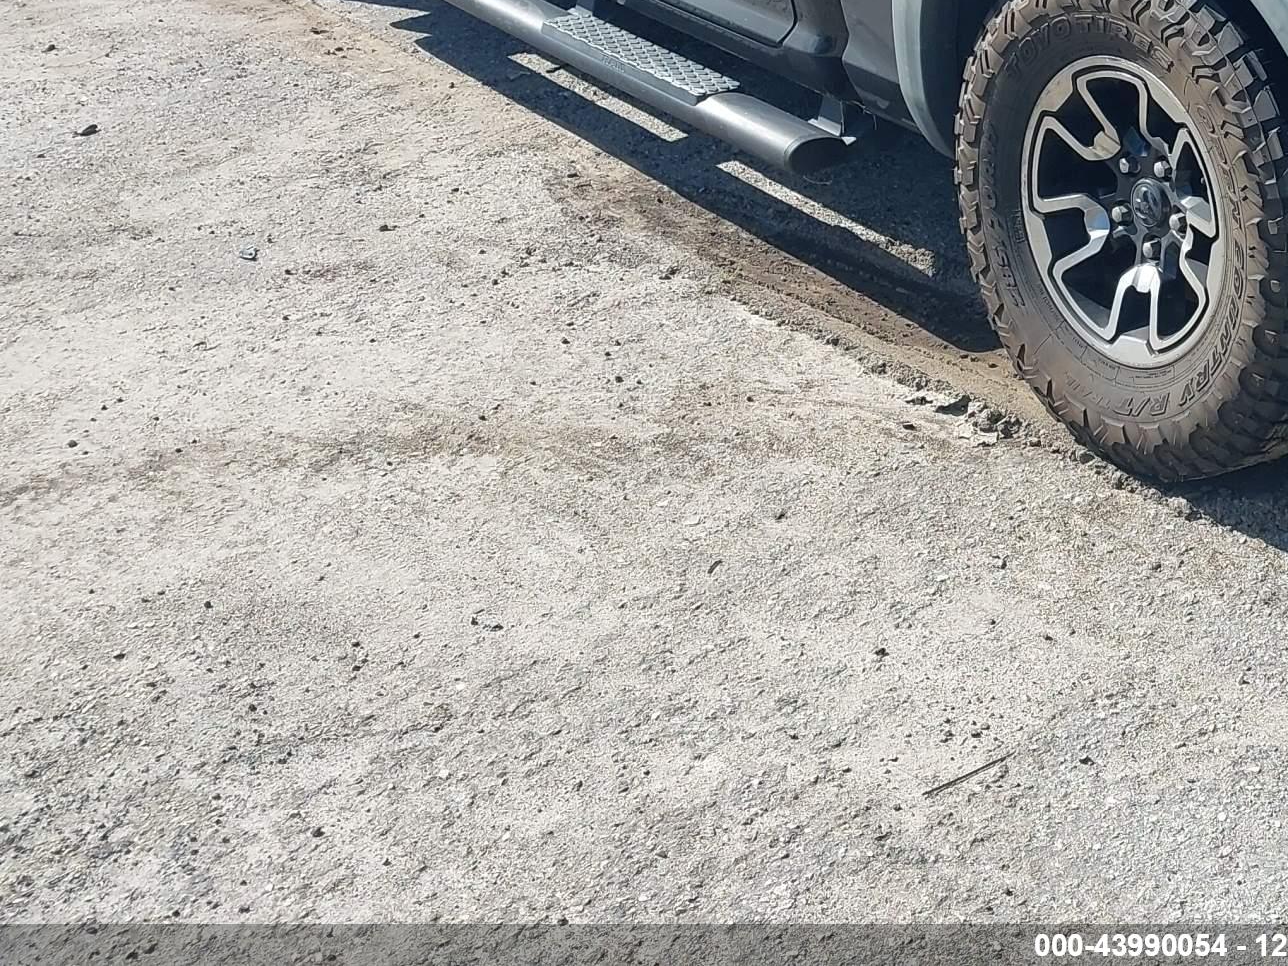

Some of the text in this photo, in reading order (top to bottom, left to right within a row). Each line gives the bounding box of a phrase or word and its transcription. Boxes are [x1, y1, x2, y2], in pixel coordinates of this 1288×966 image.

[1003, 13, 1175, 78] TOYO TIRES
[1179, 238, 1246, 408] COUNTRY
